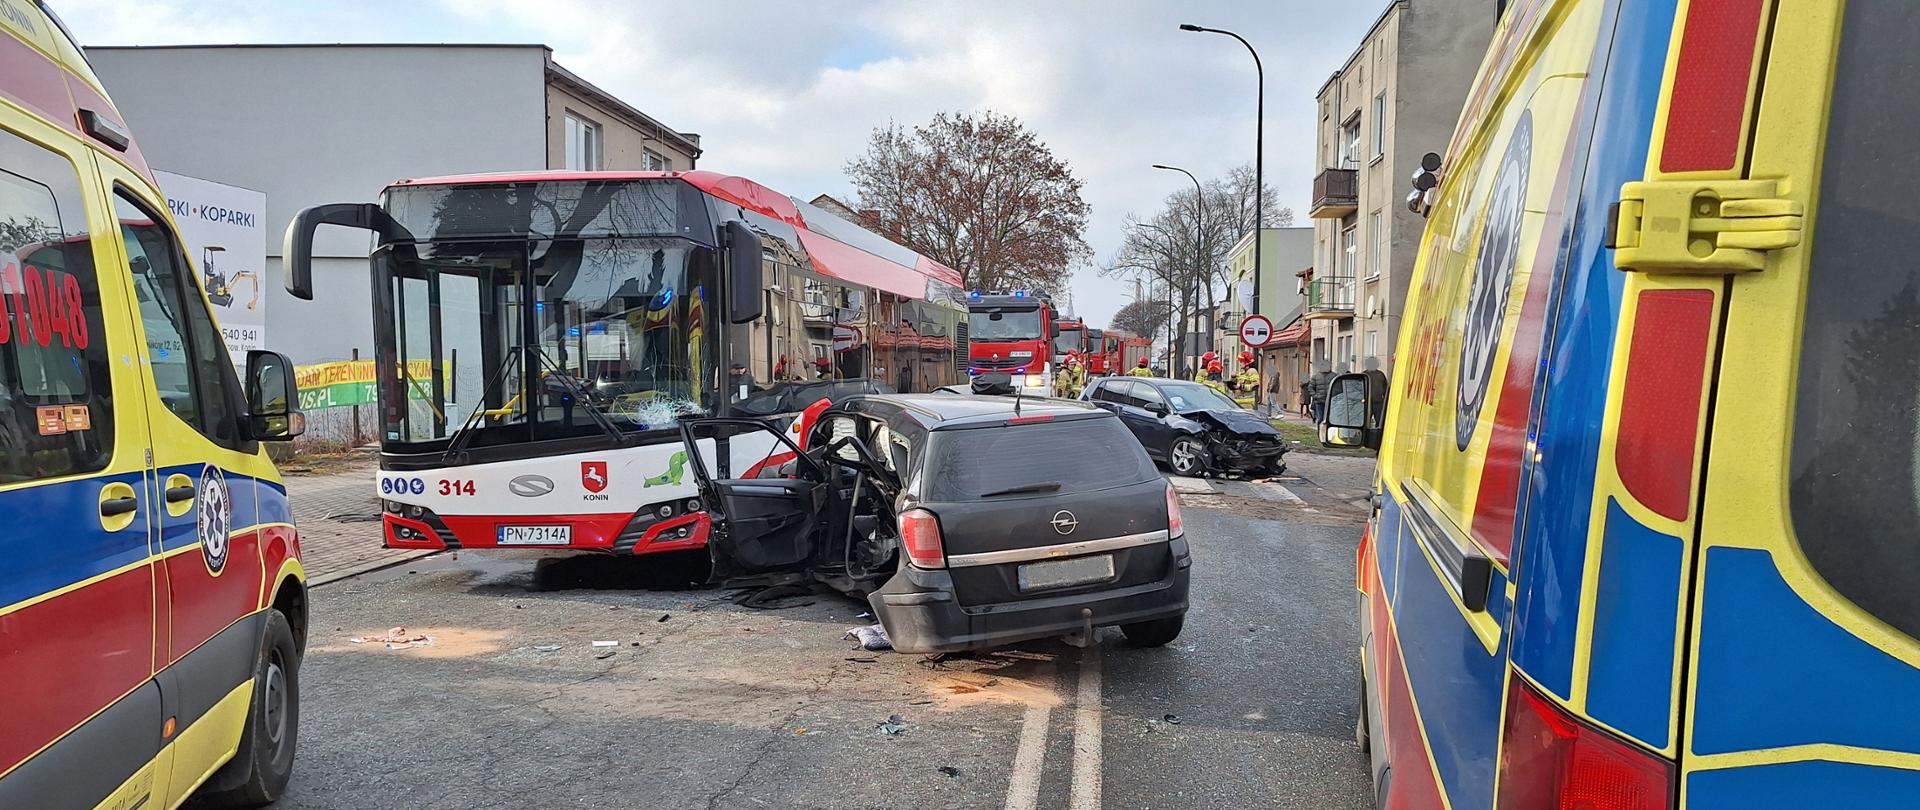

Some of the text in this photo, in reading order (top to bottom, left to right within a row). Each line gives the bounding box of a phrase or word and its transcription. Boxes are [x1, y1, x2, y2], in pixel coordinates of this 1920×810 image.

[200, 204, 255, 228] KOPARKI
[223, 328, 257, 341] 540 941
[324, 363, 356, 383] TEREN
[438, 479, 477, 496] 314
[506, 527, 567, 541] PN 7314A
